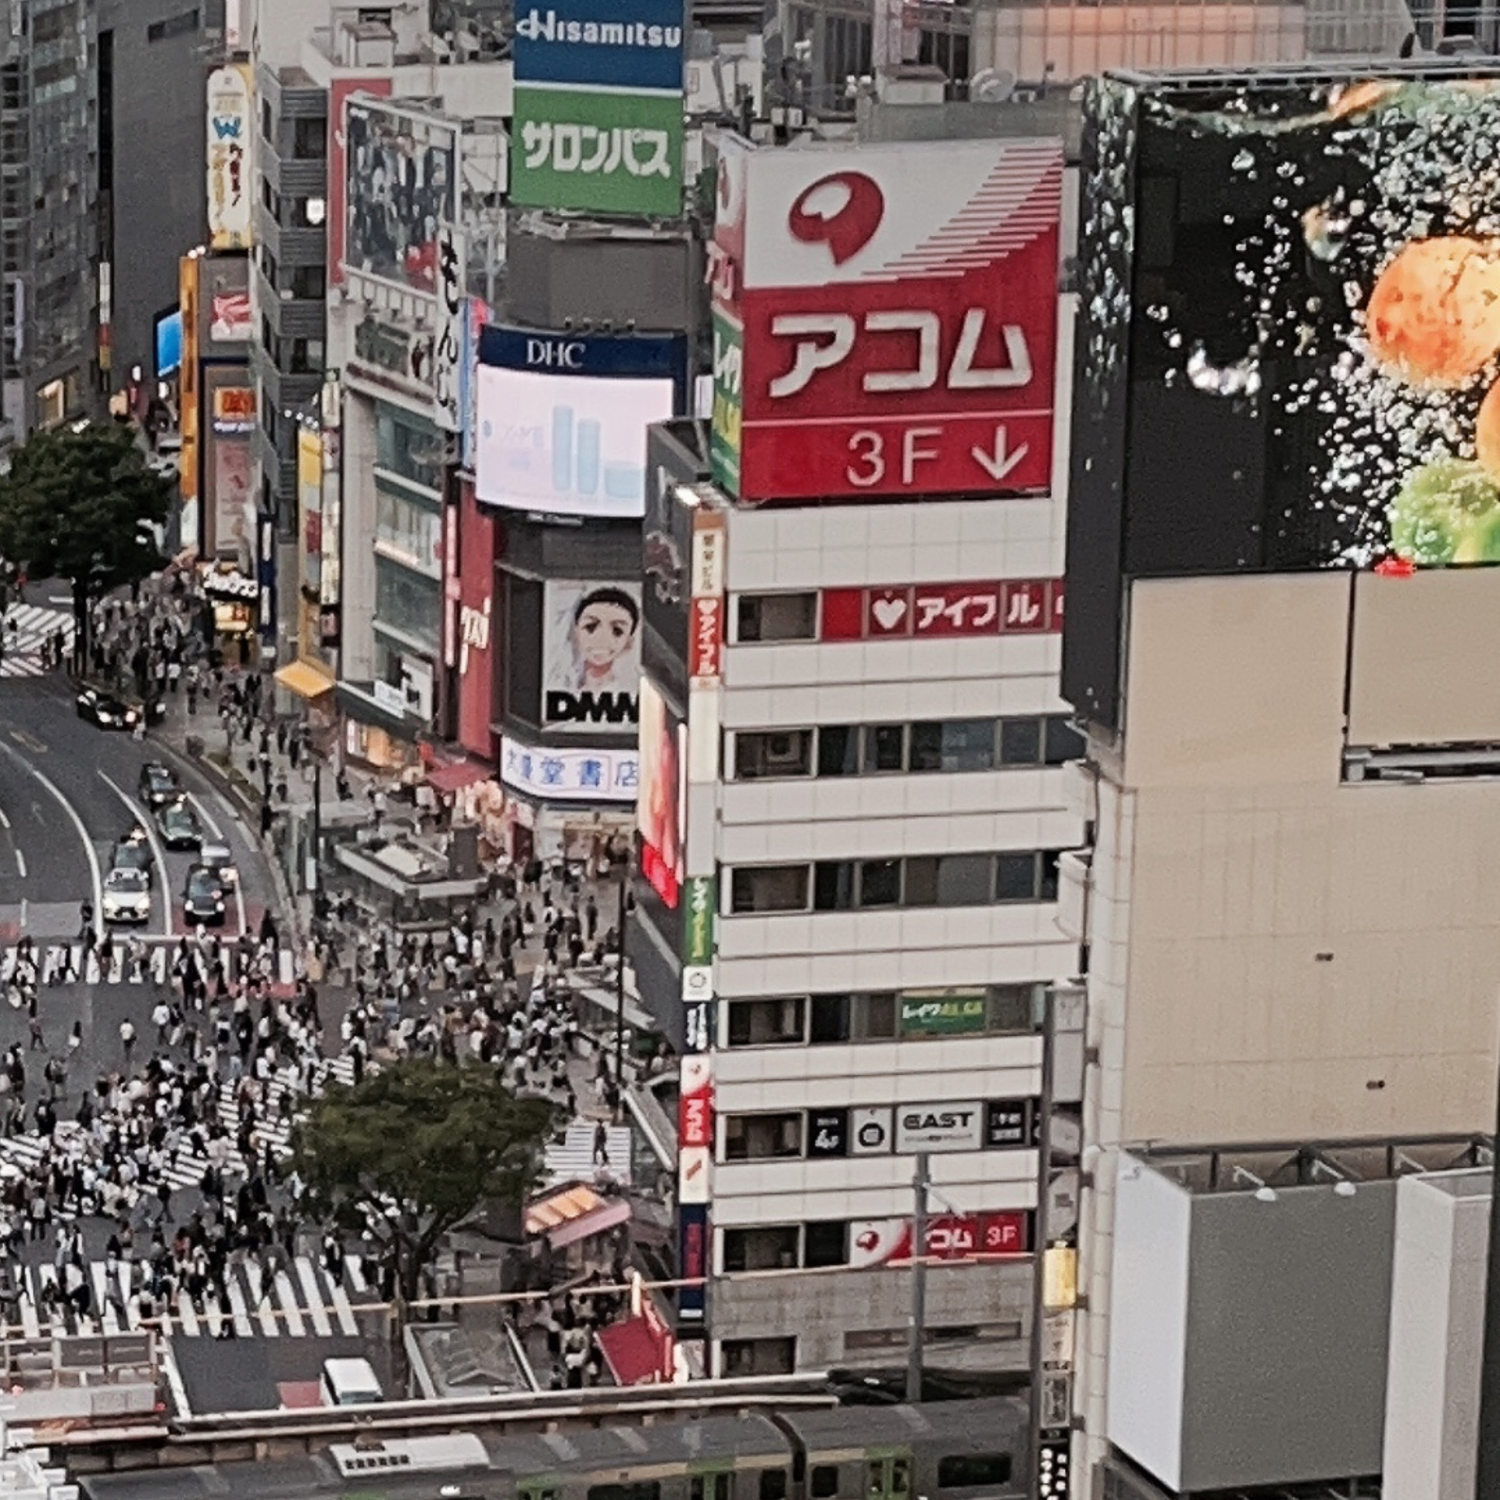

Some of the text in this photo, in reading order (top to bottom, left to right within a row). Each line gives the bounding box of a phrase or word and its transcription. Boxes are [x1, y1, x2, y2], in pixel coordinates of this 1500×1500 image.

[516, 9, 681, 48] Hisamitsu
[522, 121, 671, 178] サロンパス
[527, 338, 585, 368] DHC
[768, 307, 1034, 398] アコム
[846, 427, 943, 487] 3F
[916, 595, 1041, 629] アイフル
[902, 1112, 975, 1130] EAST
[986, 1225, 1017, 1246] 3F
